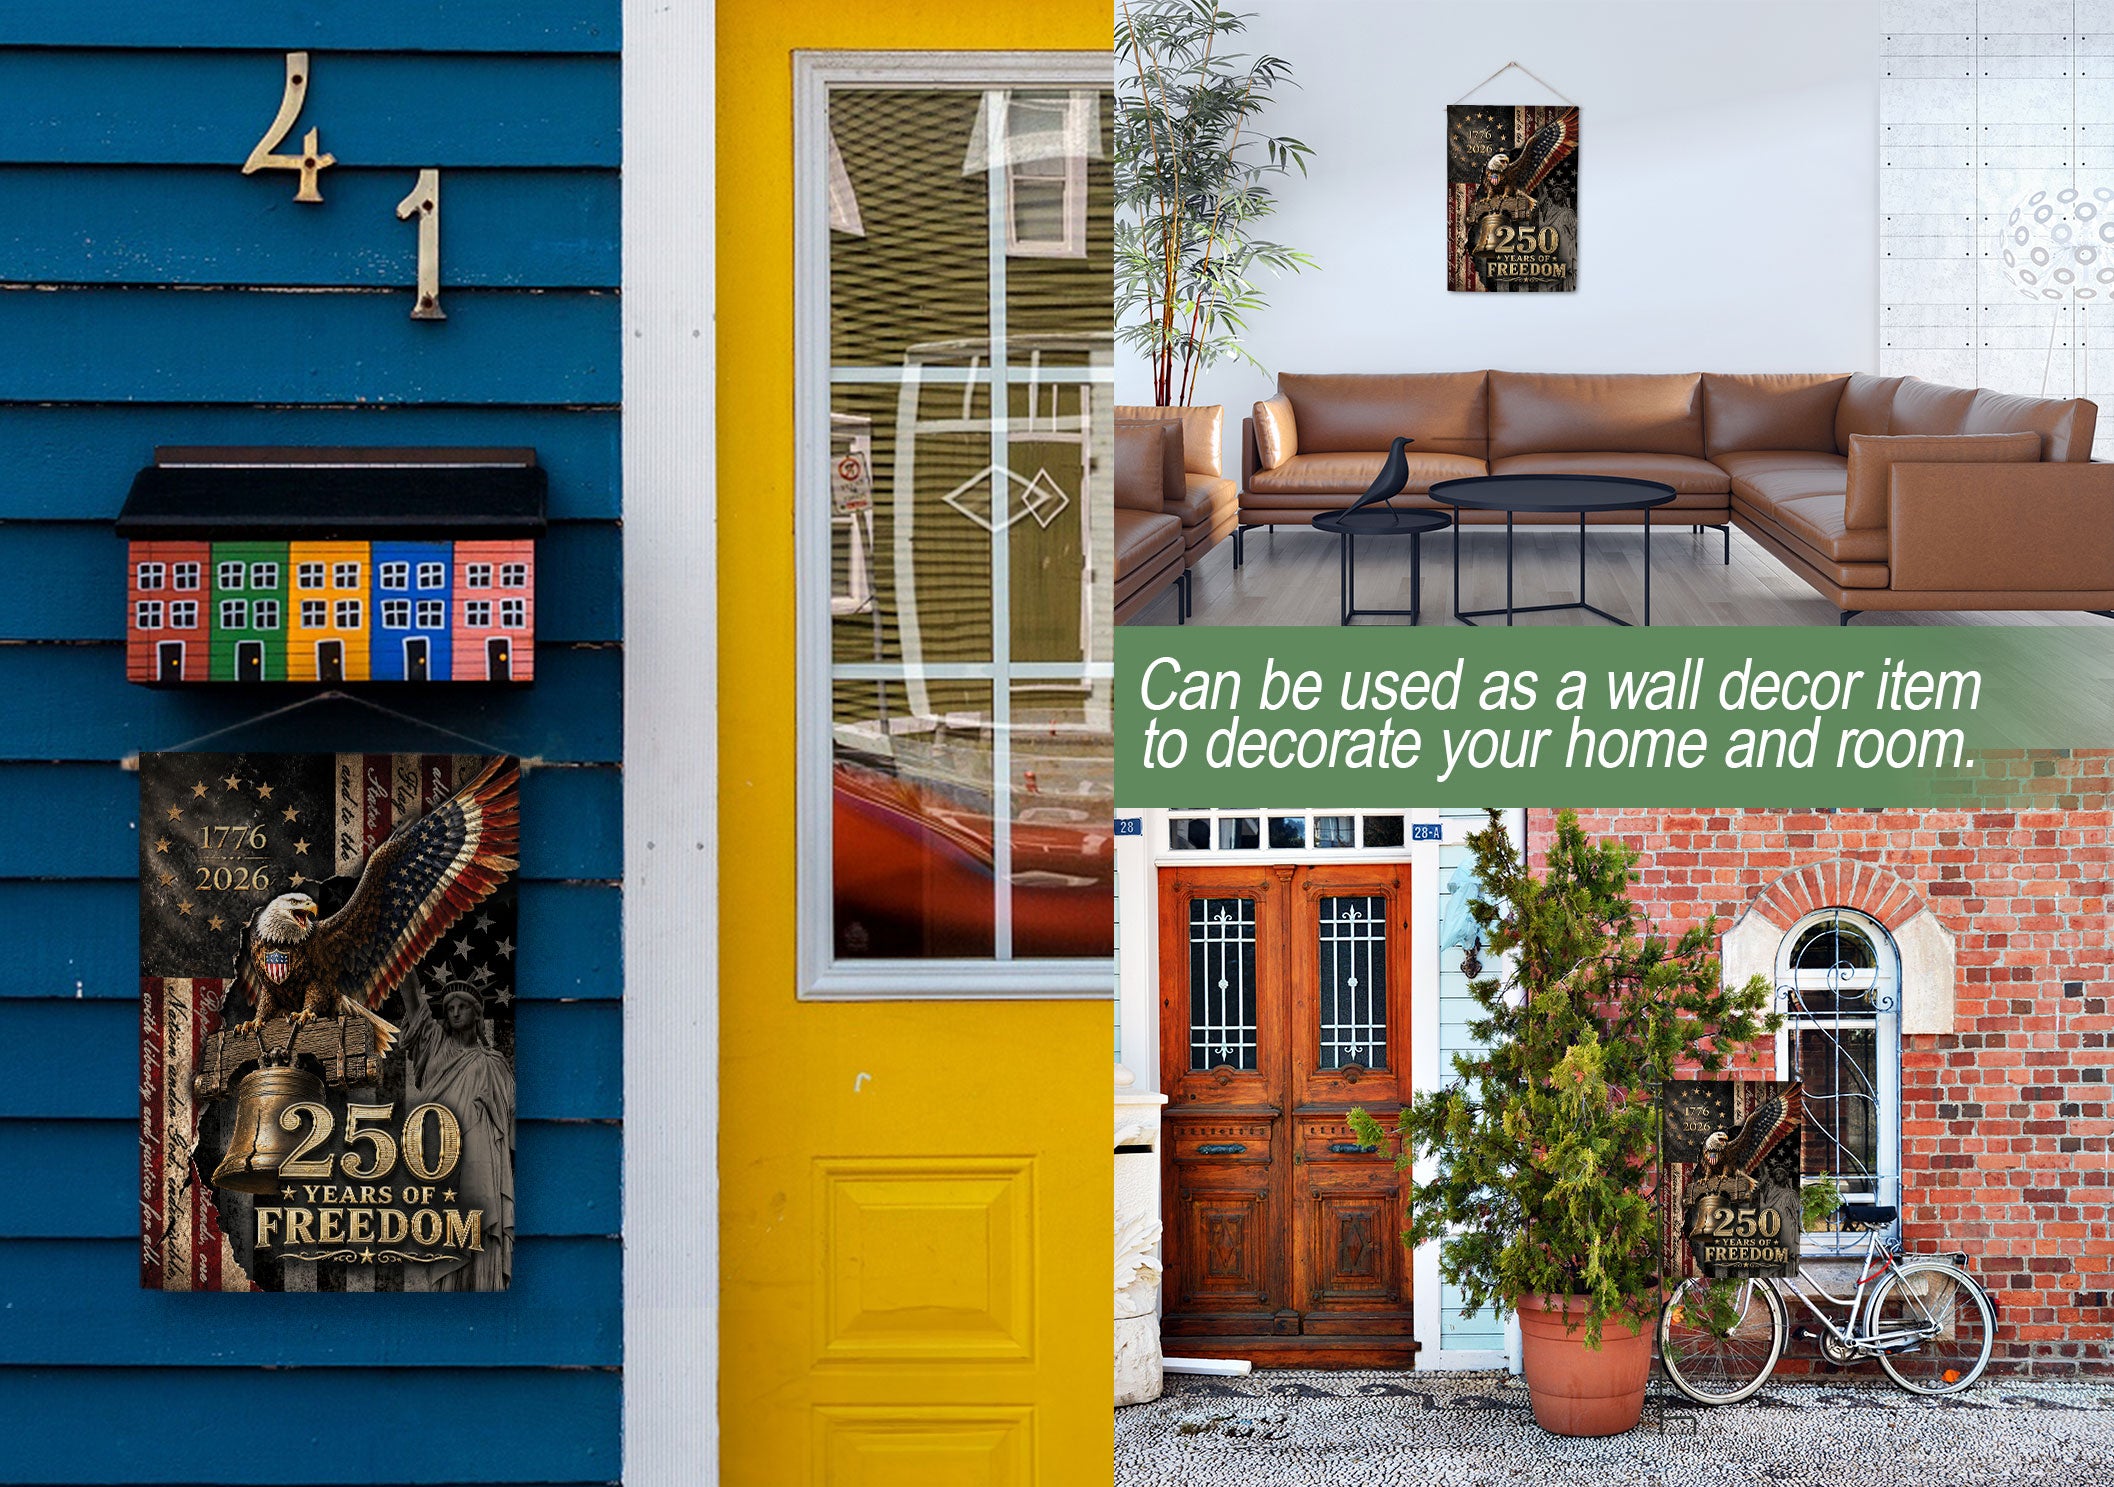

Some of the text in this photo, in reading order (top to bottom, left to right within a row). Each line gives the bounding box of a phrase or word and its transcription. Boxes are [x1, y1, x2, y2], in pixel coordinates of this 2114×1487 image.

[1467, 129, 1493, 140] 1776
[1466, 144, 1493, 154] 2026
[1494, 225, 1560, 255] 250
[1487, 261, 1567, 279] FREEDOM
[1504, 254, 1551, 262] YEARS OF
[367, 767, 388, 831] States
[340, 764, 358, 862] and to the
[200, 824, 267, 851] 1776
[1120, 821, 1134, 833] 28
[1414, 826, 1440, 839] 28-A
[196, 865, 269, 891] 2026
[143, 992, 160, 1035] with
[168, 986, 188, 1061] Nation
[139, 1038, 160, 1101] liberty
[143, 1106, 160, 1144] and
[1684, 1106, 1710, 1117] 1776
[1683, 1121, 1711, 1132] 2026
[277, 1101, 462, 1182] 250
[139, 1138, 157, 1199] justice
[302, 1184, 436, 1204] YEARS OF
[139, 1200, 162, 1230] for
[1713, 1208, 1781, 1238] 250
[254, 1206, 485, 1252] FREEDOM
[1722, 1238, 1772, 1246] YEARS OF
[1704, 1246, 1789, 1264] FREEDOM
